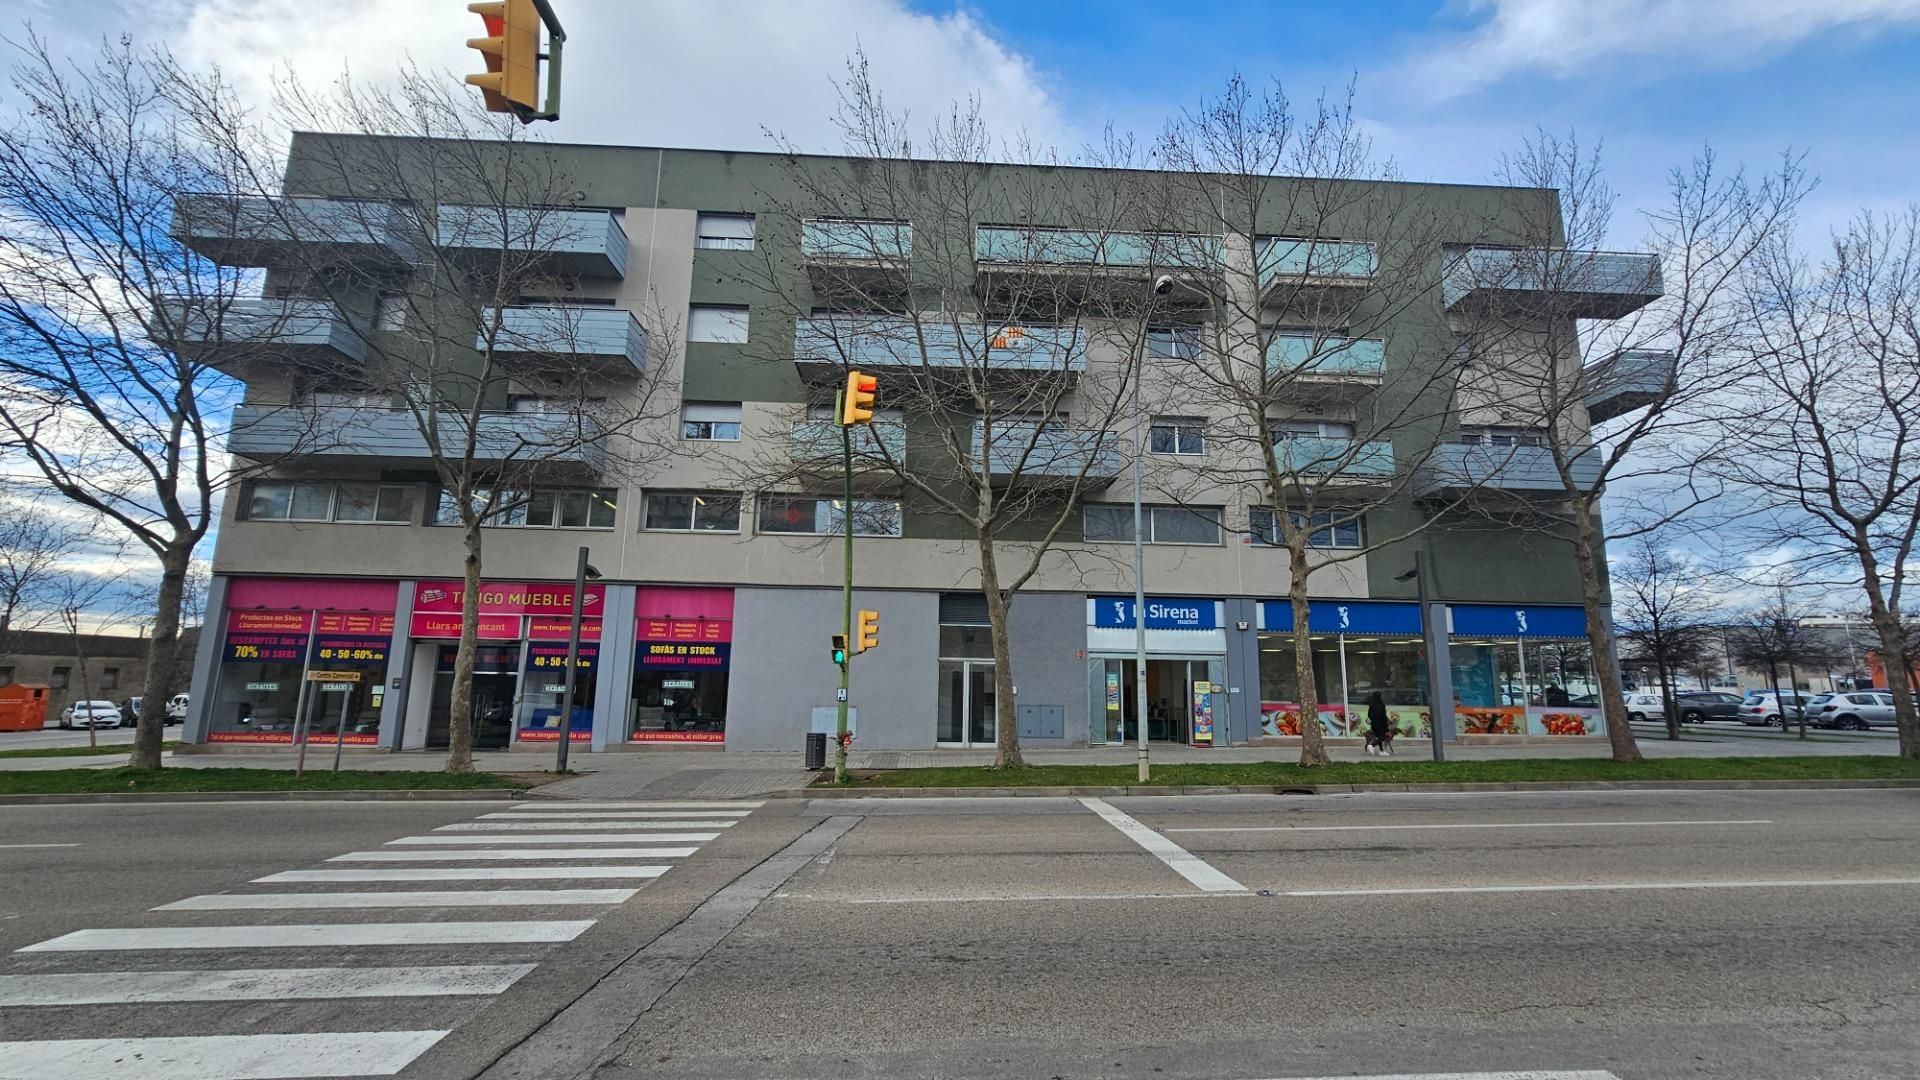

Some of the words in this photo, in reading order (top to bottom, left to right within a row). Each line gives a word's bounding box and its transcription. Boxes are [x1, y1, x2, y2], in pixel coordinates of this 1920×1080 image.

[452, 592, 504, 604] TGO
[508, 593, 572, 606] MUEBLE
[1150, 604, 1198, 618] Sirena
[426, 622, 450, 630] Llars
[478, 623, 505, 631] ncant
[234, 645, 258, 657] 70%
[320, 649, 331, 659] 40
[338, 649, 350, 659] 50
[690, 646, 715, 654] STOCK
[535, 657, 545, 666] 40
[550, 657, 560, 666] 50
